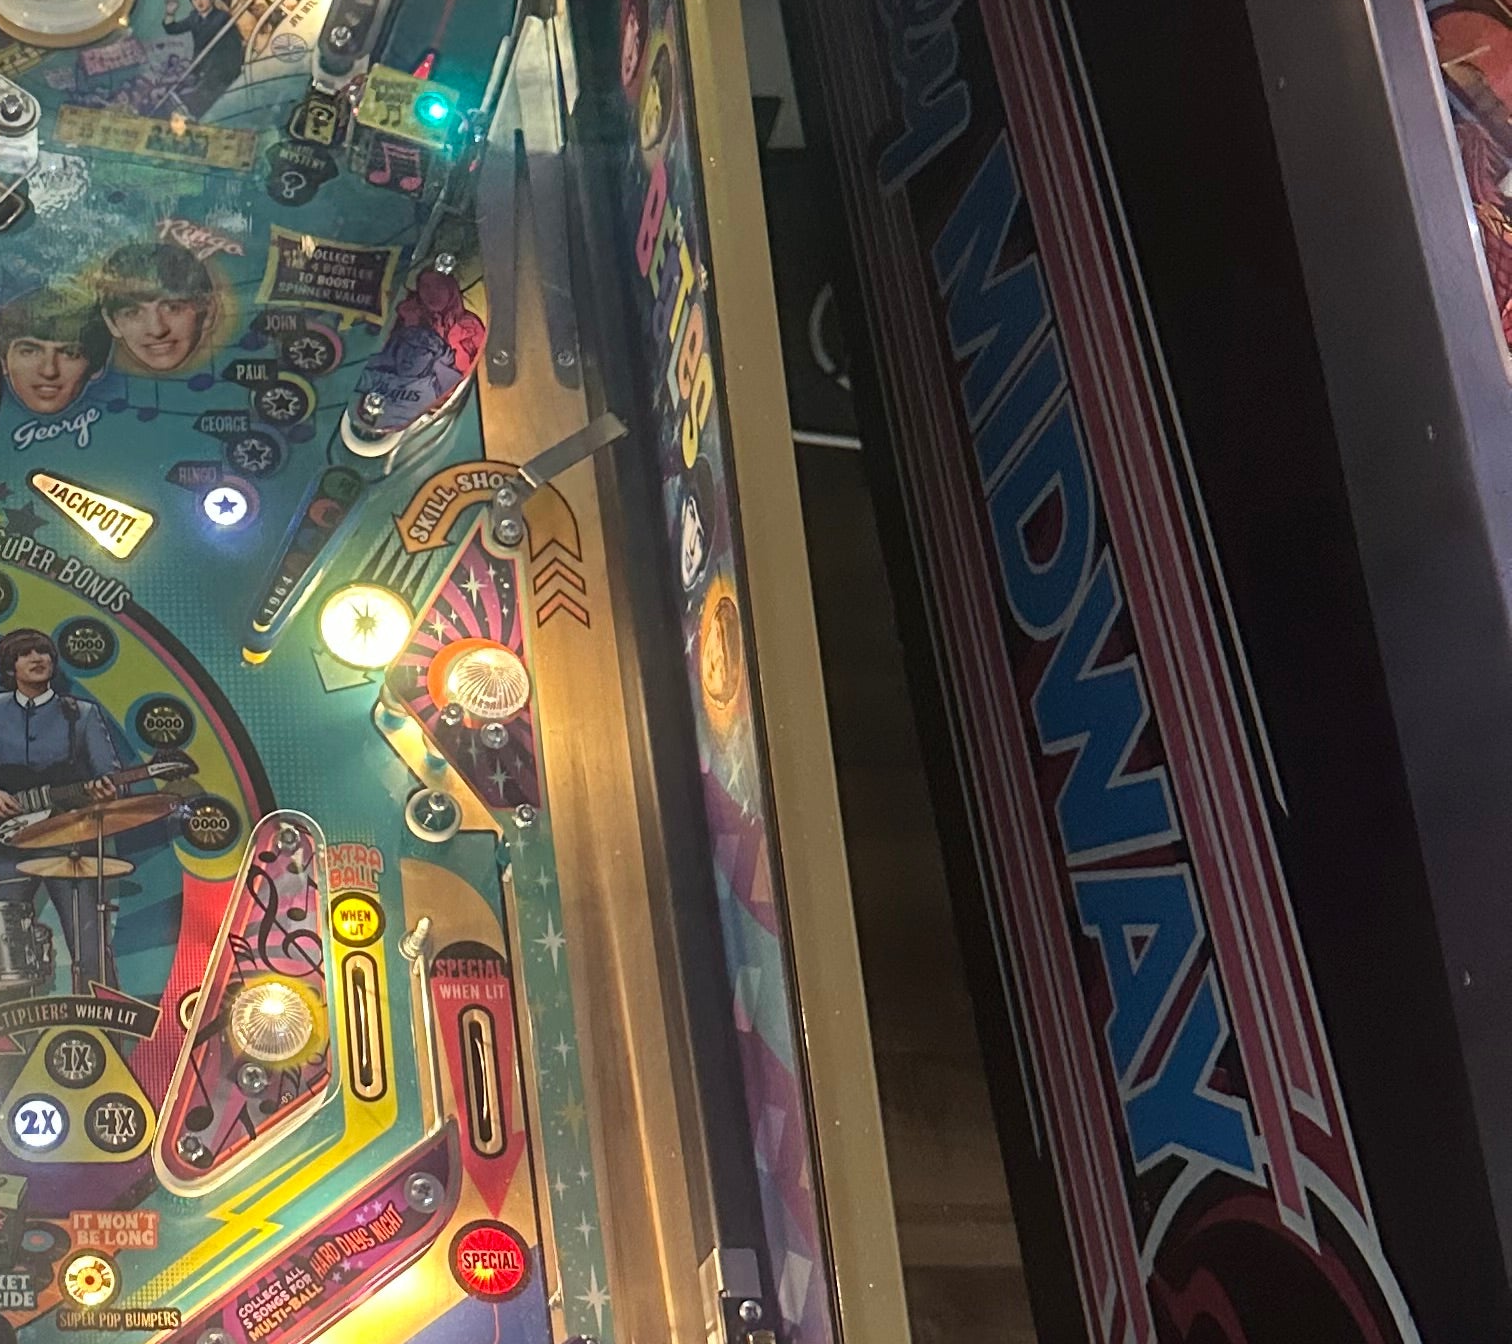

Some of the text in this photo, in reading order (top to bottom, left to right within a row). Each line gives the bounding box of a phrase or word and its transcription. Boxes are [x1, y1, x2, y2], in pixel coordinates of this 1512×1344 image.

[236, 363, 268, 381] PAUL
[14, 406, 100, 449] George
[47, 481, 138, 544] JACKPOT!
[409, 483, 456, 543] SKILL
[59, 559, 131, 612] BONUS
[67, 637, 103, 651] 7000
[931, 128, 1267, 1184] MIDWAY
[191, 817, 227, 831] 9000
[340, 911, 372, 922] WHEN
[350, 924, 364, 936] LIT
[439, 984, 505, 1000] WHEN LIT
[75, 1005, 138, 1025] WHEN LIT
[20, 1110, 57, 1135] 2X
[96, 1107, 135, 1136] 4X
[74, 1214, 157, 1230] IT WON'T
[78, 1229, 155, 1246] BE LONG
[462, 1251, 520, 1269] SPECIAL
[238, 1266, 305, 1319] COLLECT ALL
[60, 1311, 179, 1327] SUPER POP BUMPERS
[248, 1282, 324, 1342] MULTI-BALL
